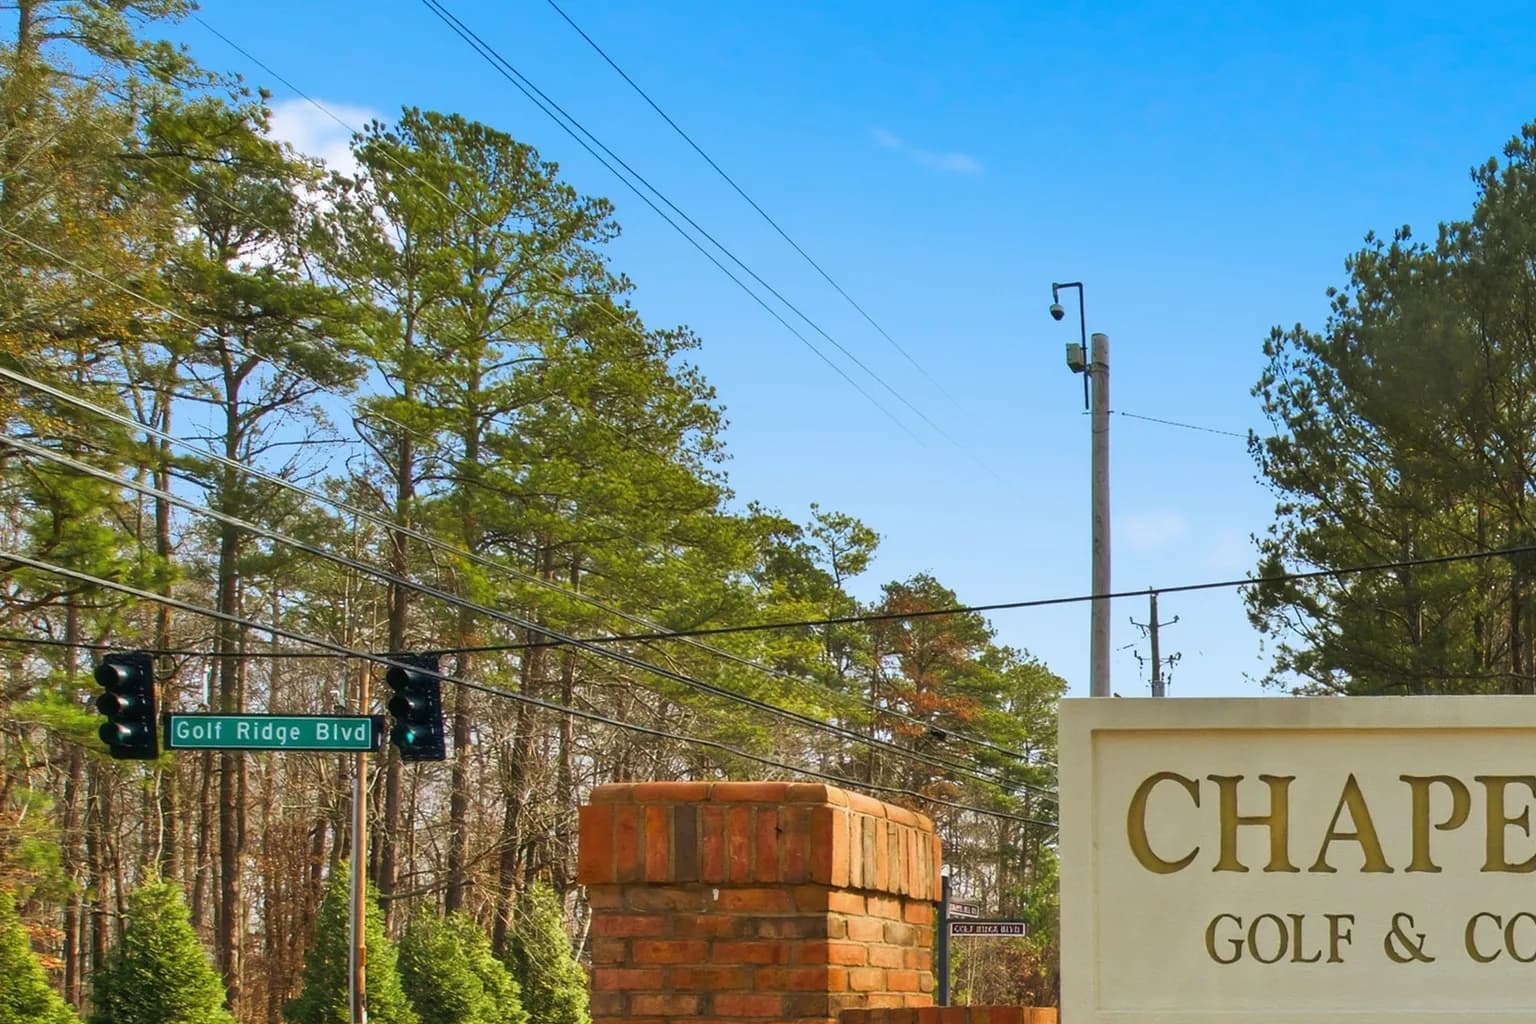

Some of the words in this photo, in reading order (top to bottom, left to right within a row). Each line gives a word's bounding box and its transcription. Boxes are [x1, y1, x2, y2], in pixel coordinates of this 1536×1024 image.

[176, 721, 222, 740] Golf
[237, 722, 300, 746] Ridge
[316, 723, 366, 741] Blvd
[1205, 911, 1357, 965] GOLF
[1384, 911, 1436, 965] &
